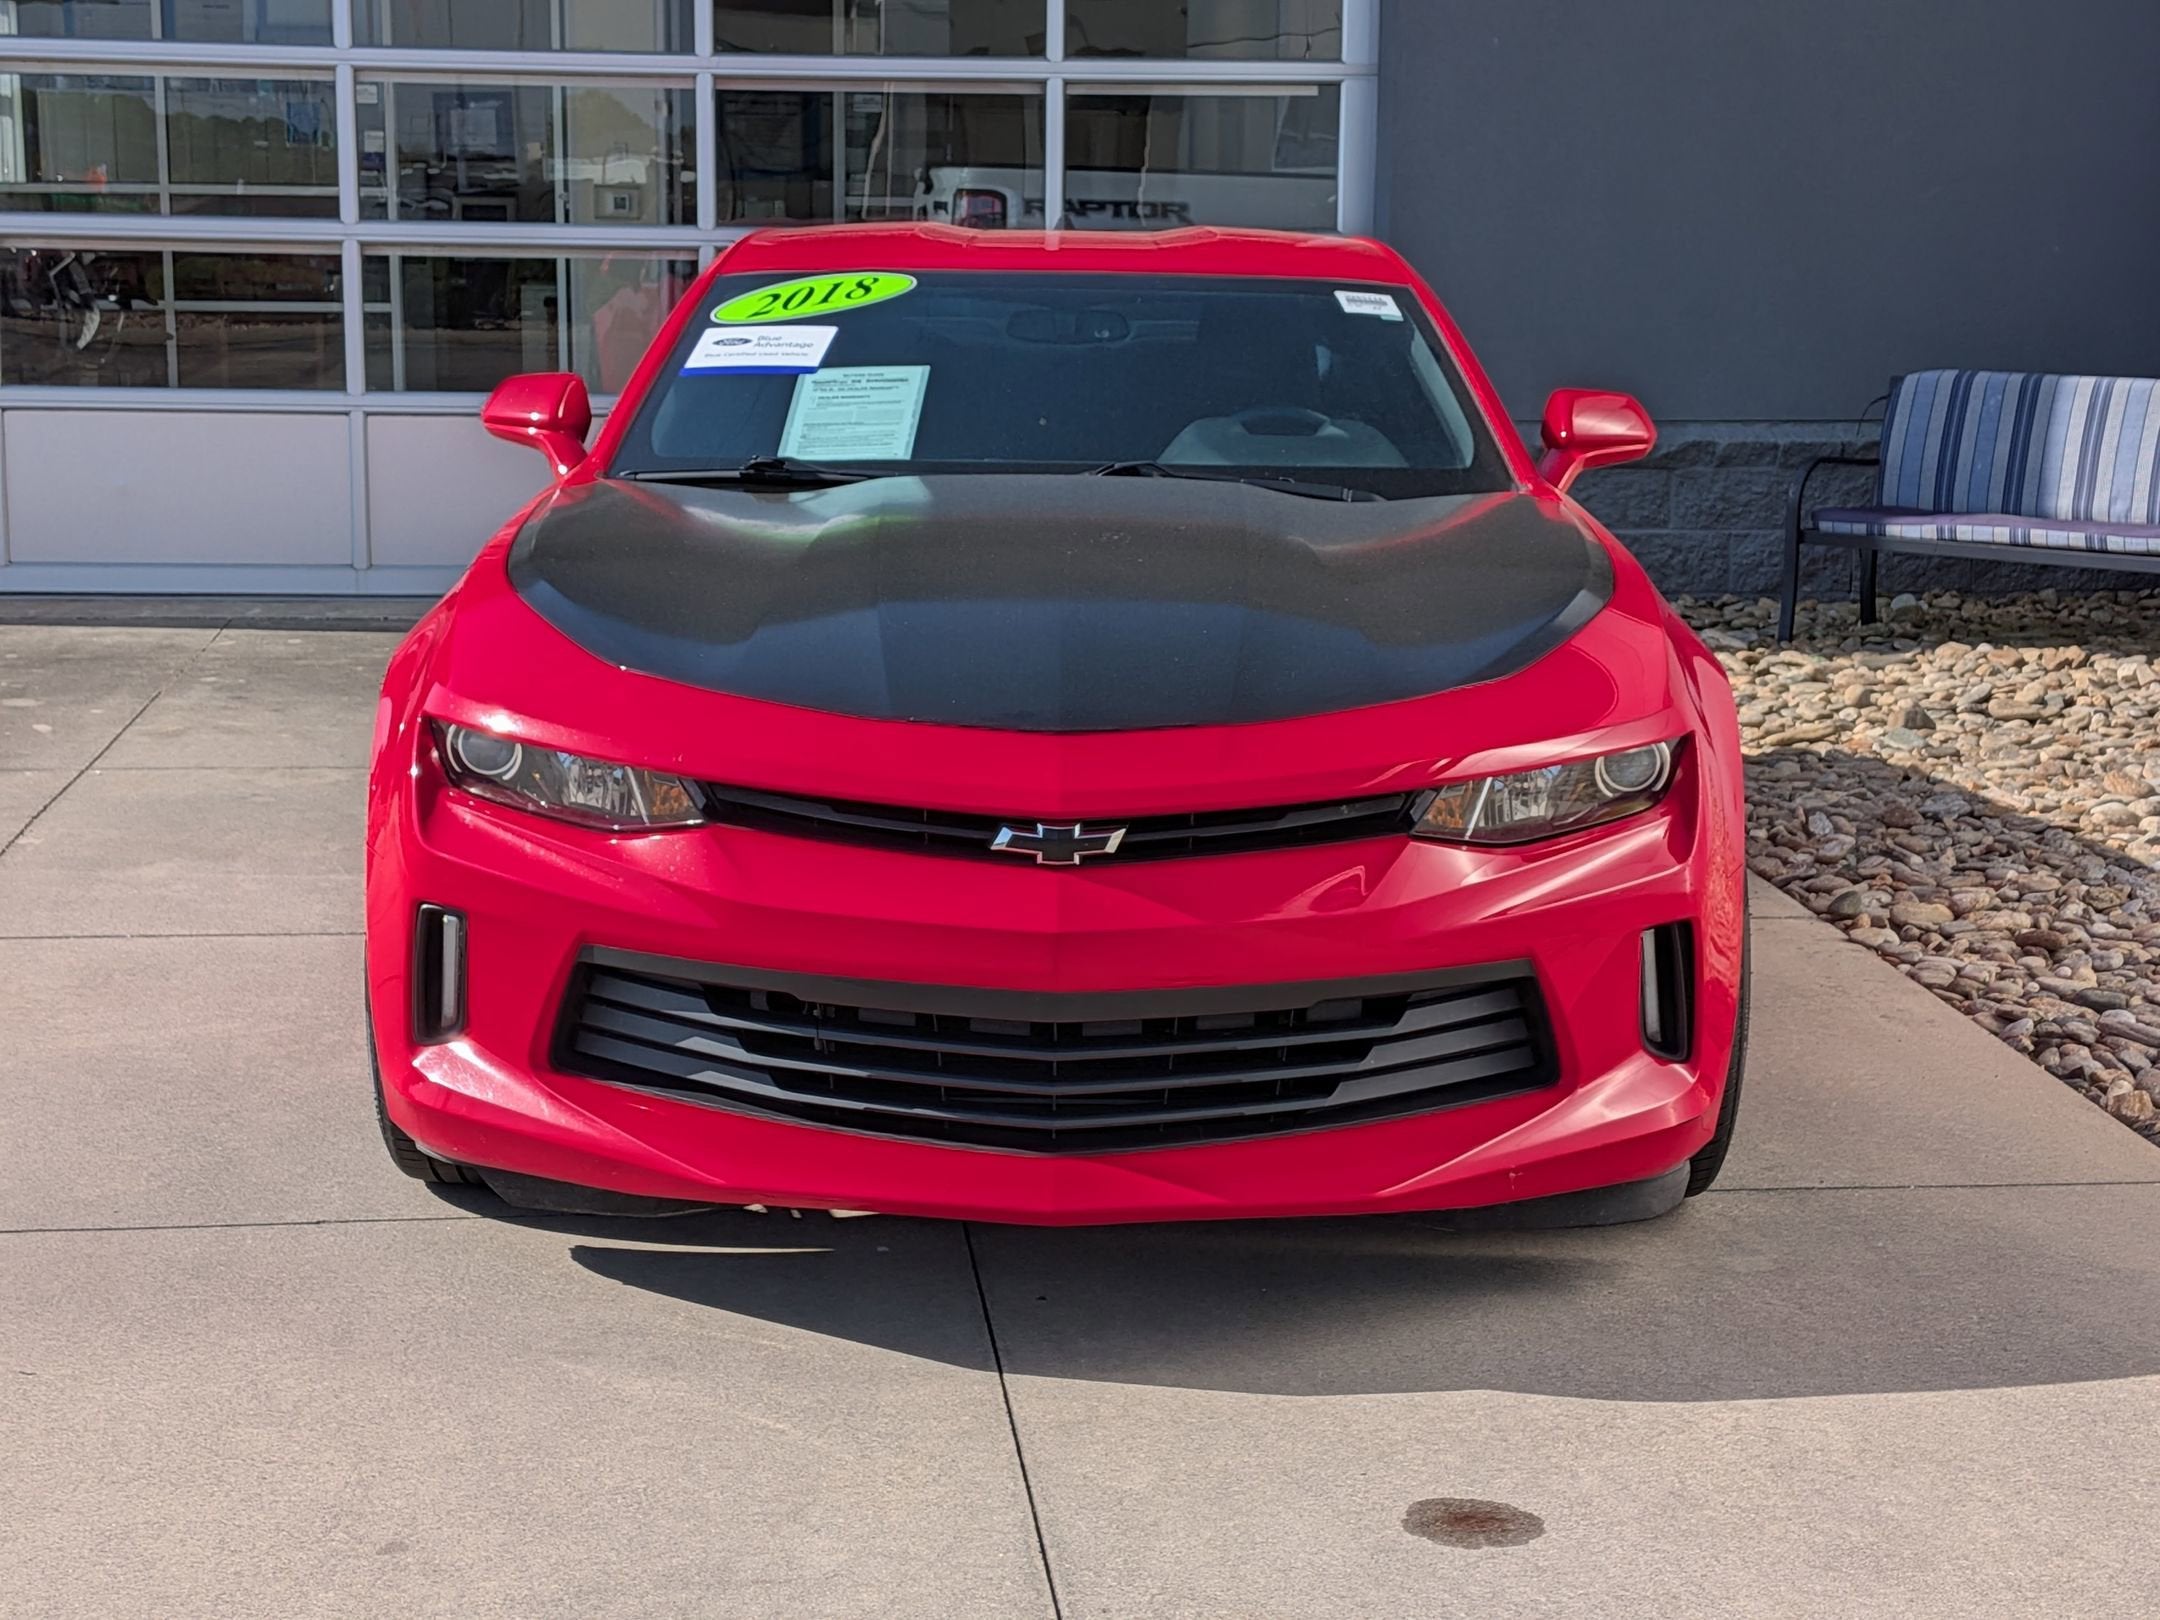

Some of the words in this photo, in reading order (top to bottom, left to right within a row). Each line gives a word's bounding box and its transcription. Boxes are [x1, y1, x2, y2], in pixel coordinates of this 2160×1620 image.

[1023, 198, 1193, 221] RAPTOR
[745, 277, 880, 319] 2018
[716, 338, 749, 346] Ford
[753, 341, 815, 349] Advantage
